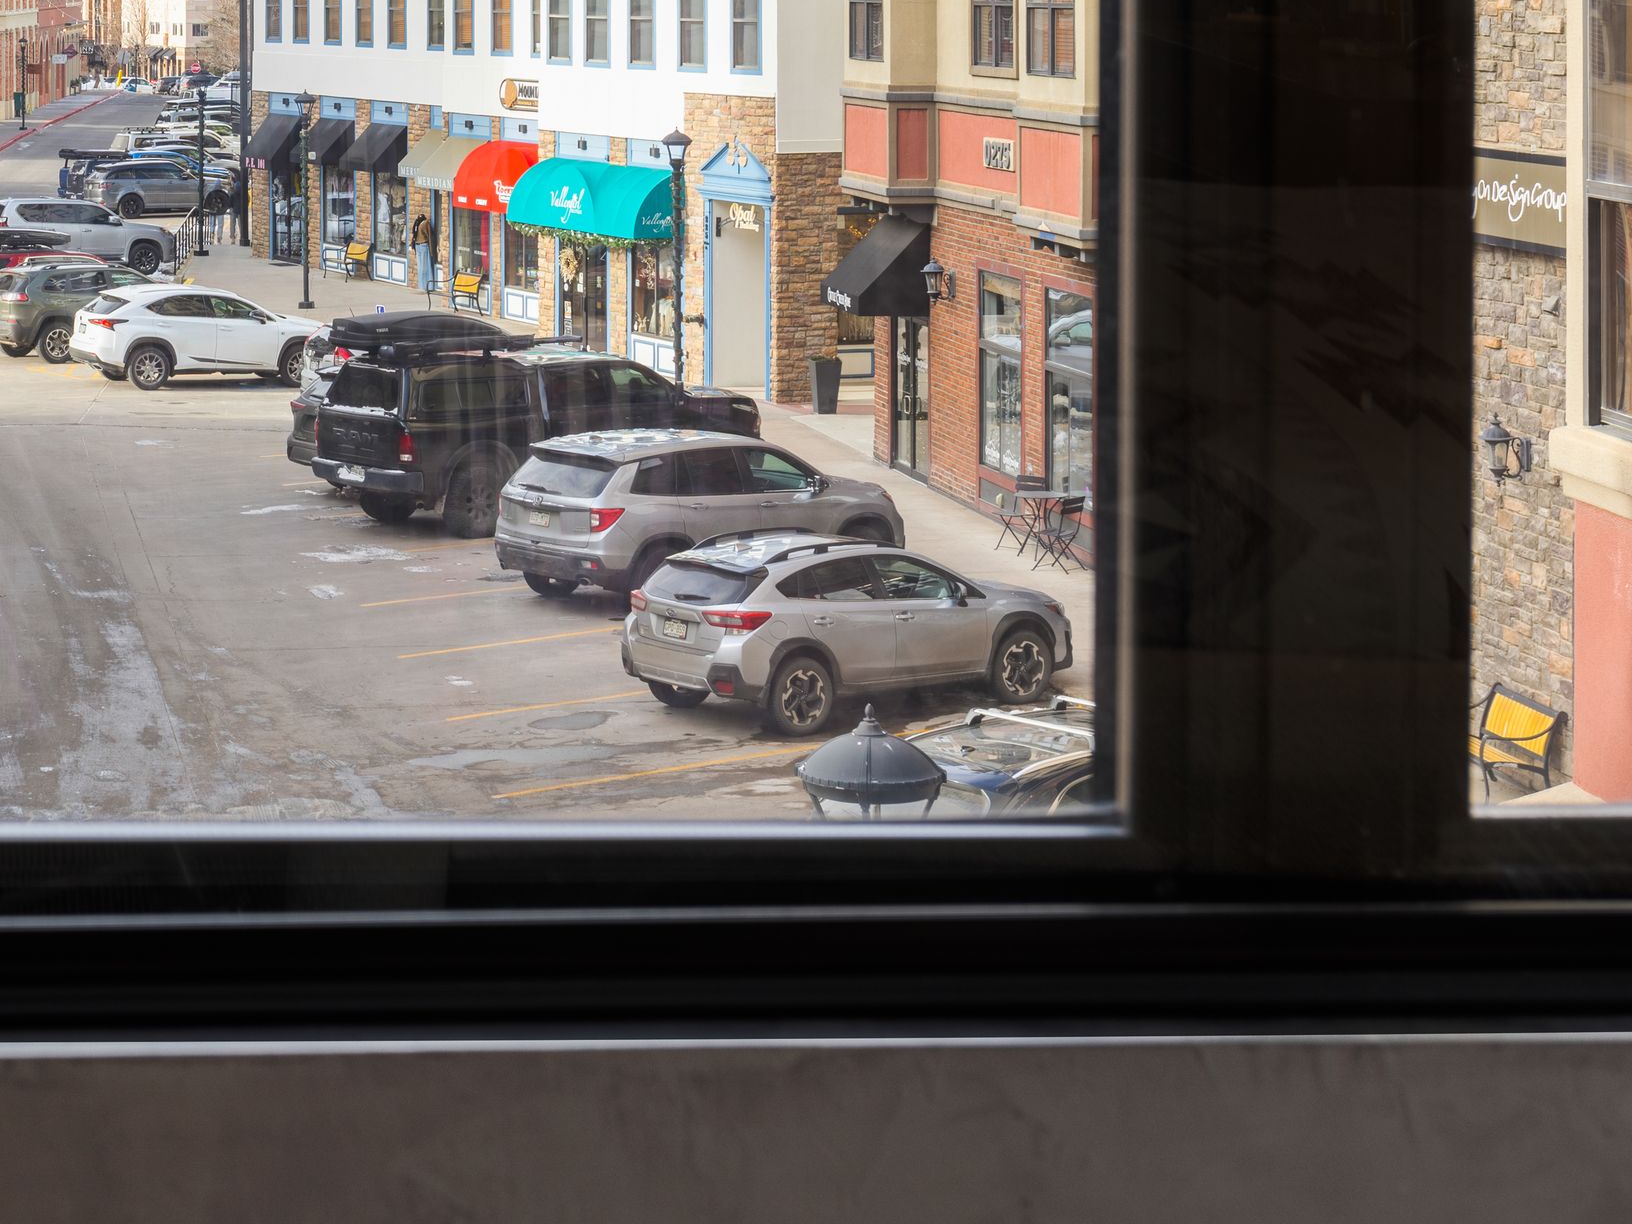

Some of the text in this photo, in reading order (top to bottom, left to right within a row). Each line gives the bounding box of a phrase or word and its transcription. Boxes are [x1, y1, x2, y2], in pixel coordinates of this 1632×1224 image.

[417, 176, 453, 189] MERIDIAN
[729, 202, 756, 229] Opal
[332, 427, 380, 445] RAM
